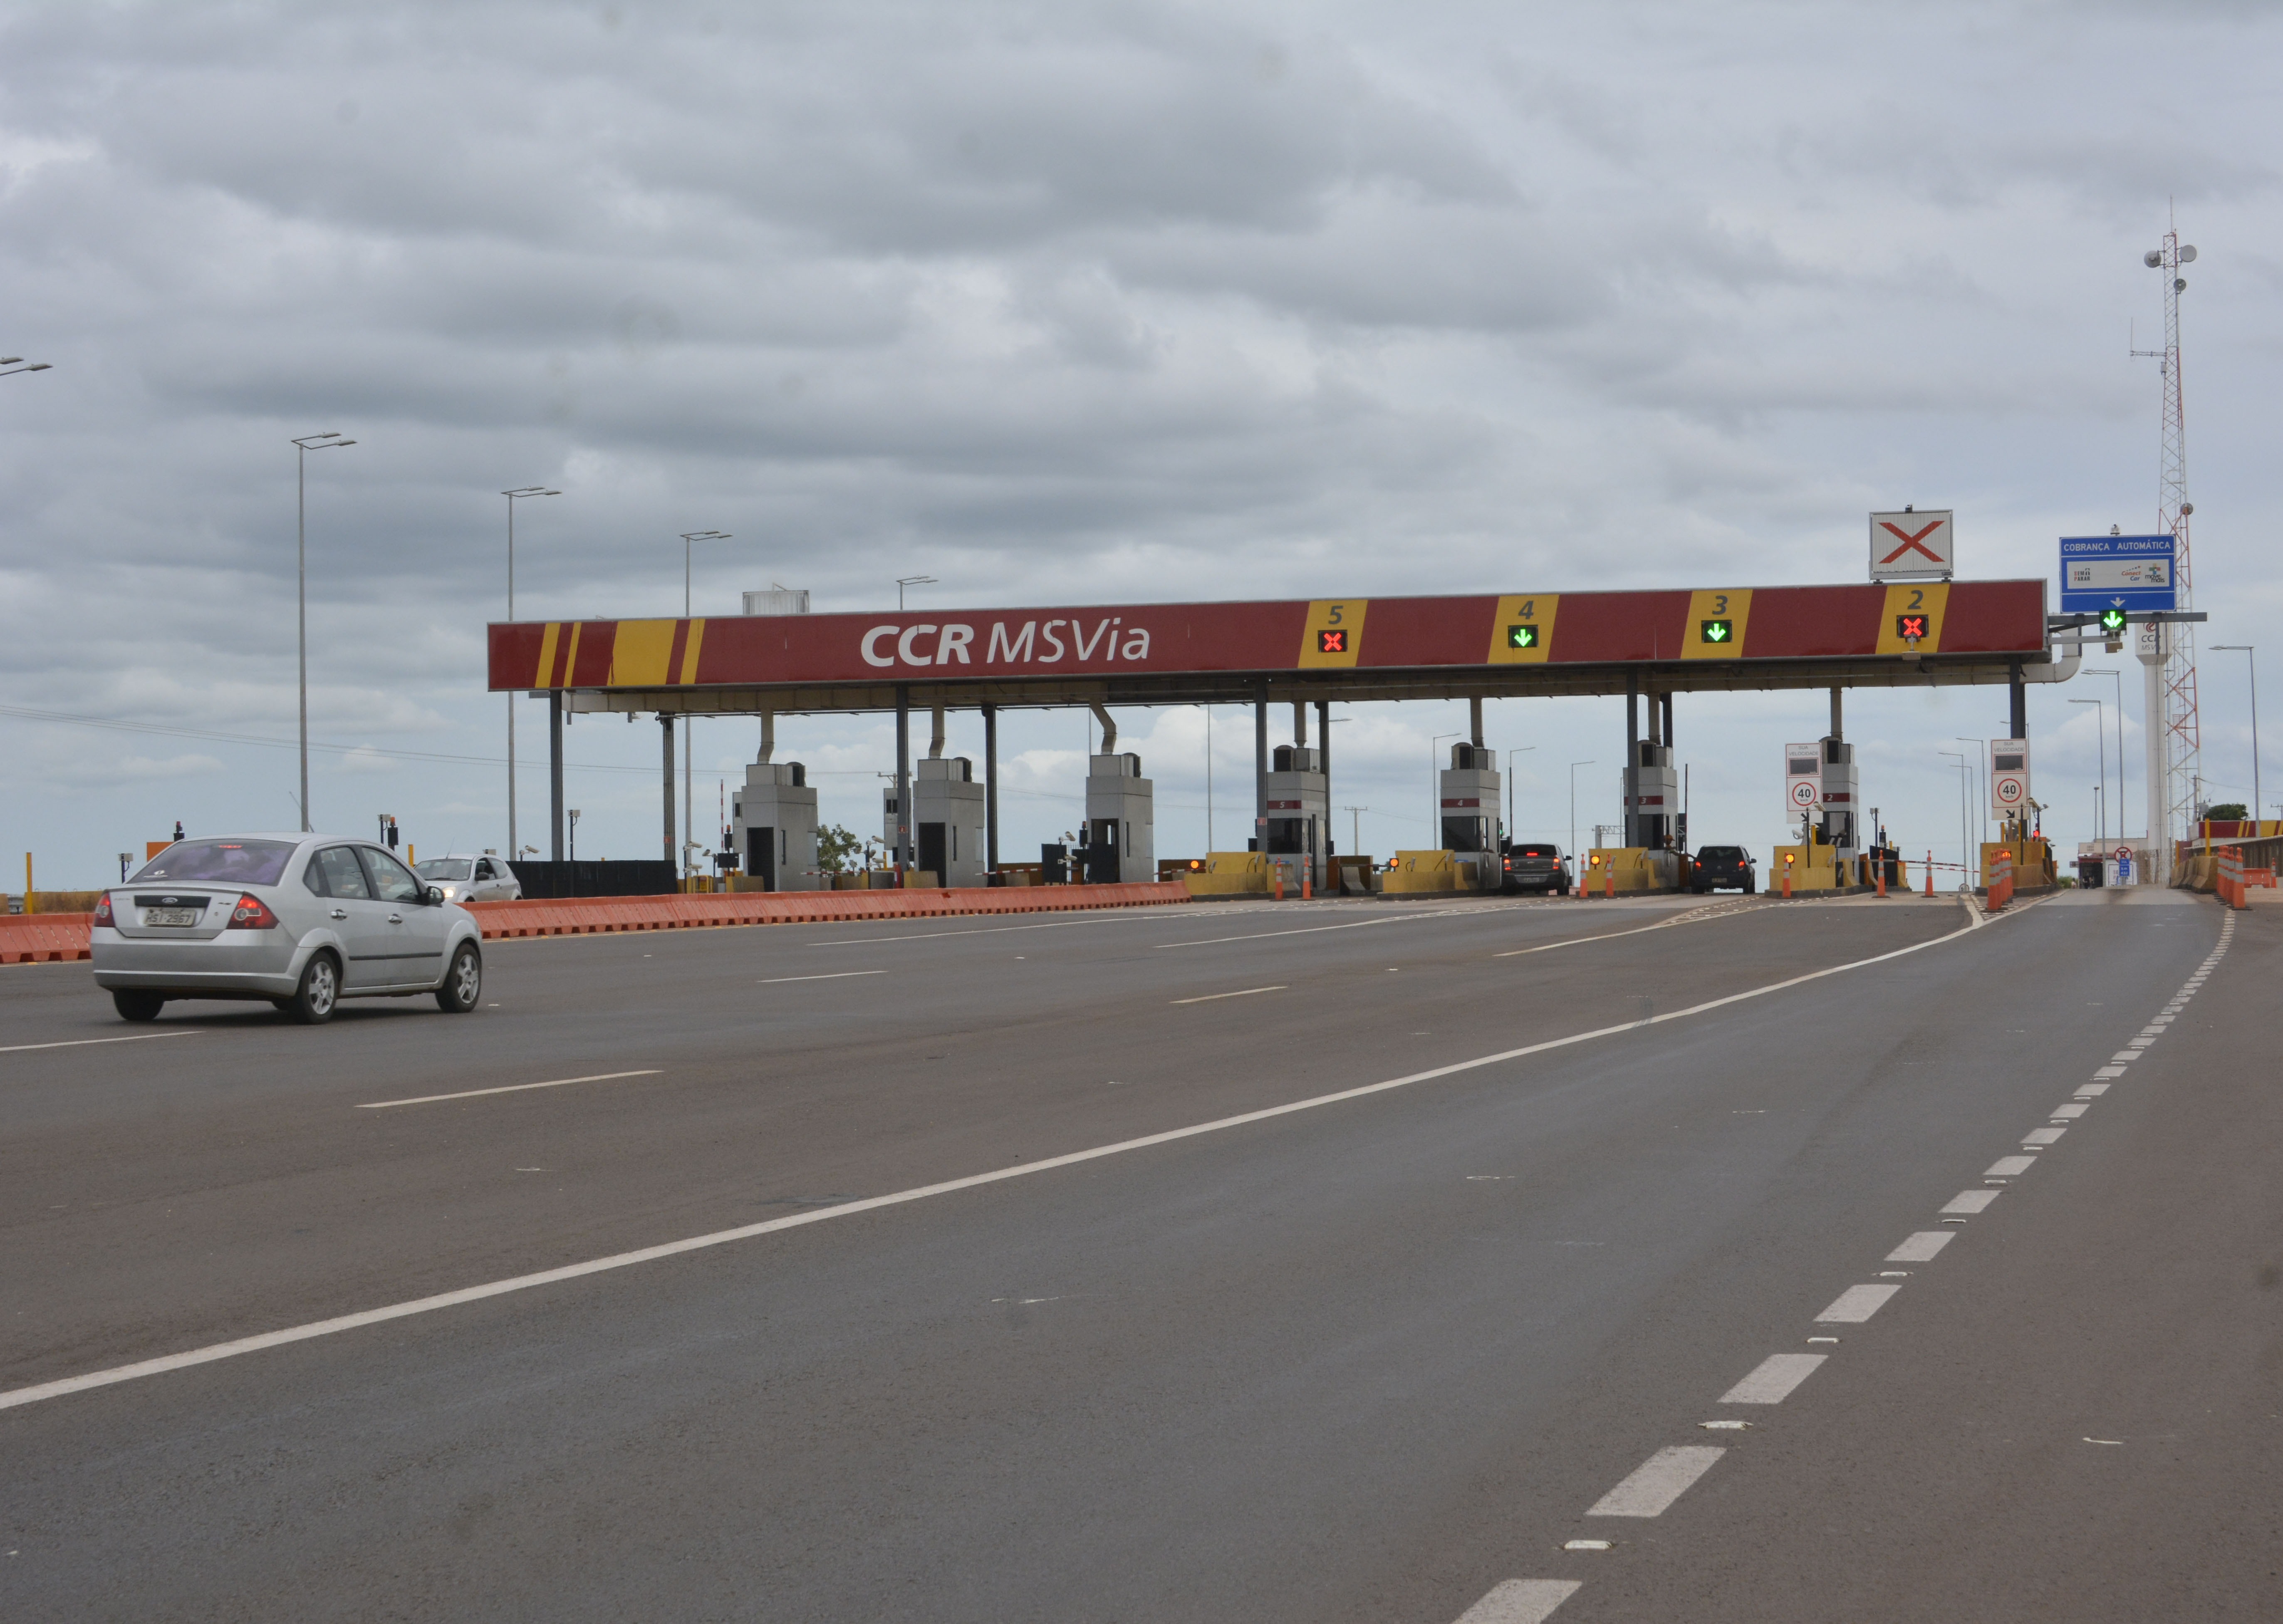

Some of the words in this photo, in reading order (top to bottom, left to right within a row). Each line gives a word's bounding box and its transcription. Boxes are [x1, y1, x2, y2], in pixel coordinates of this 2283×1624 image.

[2064, 542, 2110, 552] COBRANÇA
[2117, 540, 2171, 550] AUTOMÁTICA
[1711, 595, 1728, 615] 3
[1907, 589, 1924, 610] 2
[1328, 605, 1344, 625] 5
[1518, 600, 1534, 620] 4
[861, 624, 974, 667] CCR
[986, 617, 1150, 663] MSVia
[1798, 789, 1811, 798] 40
[2003, 785, 2016, 794] 40
